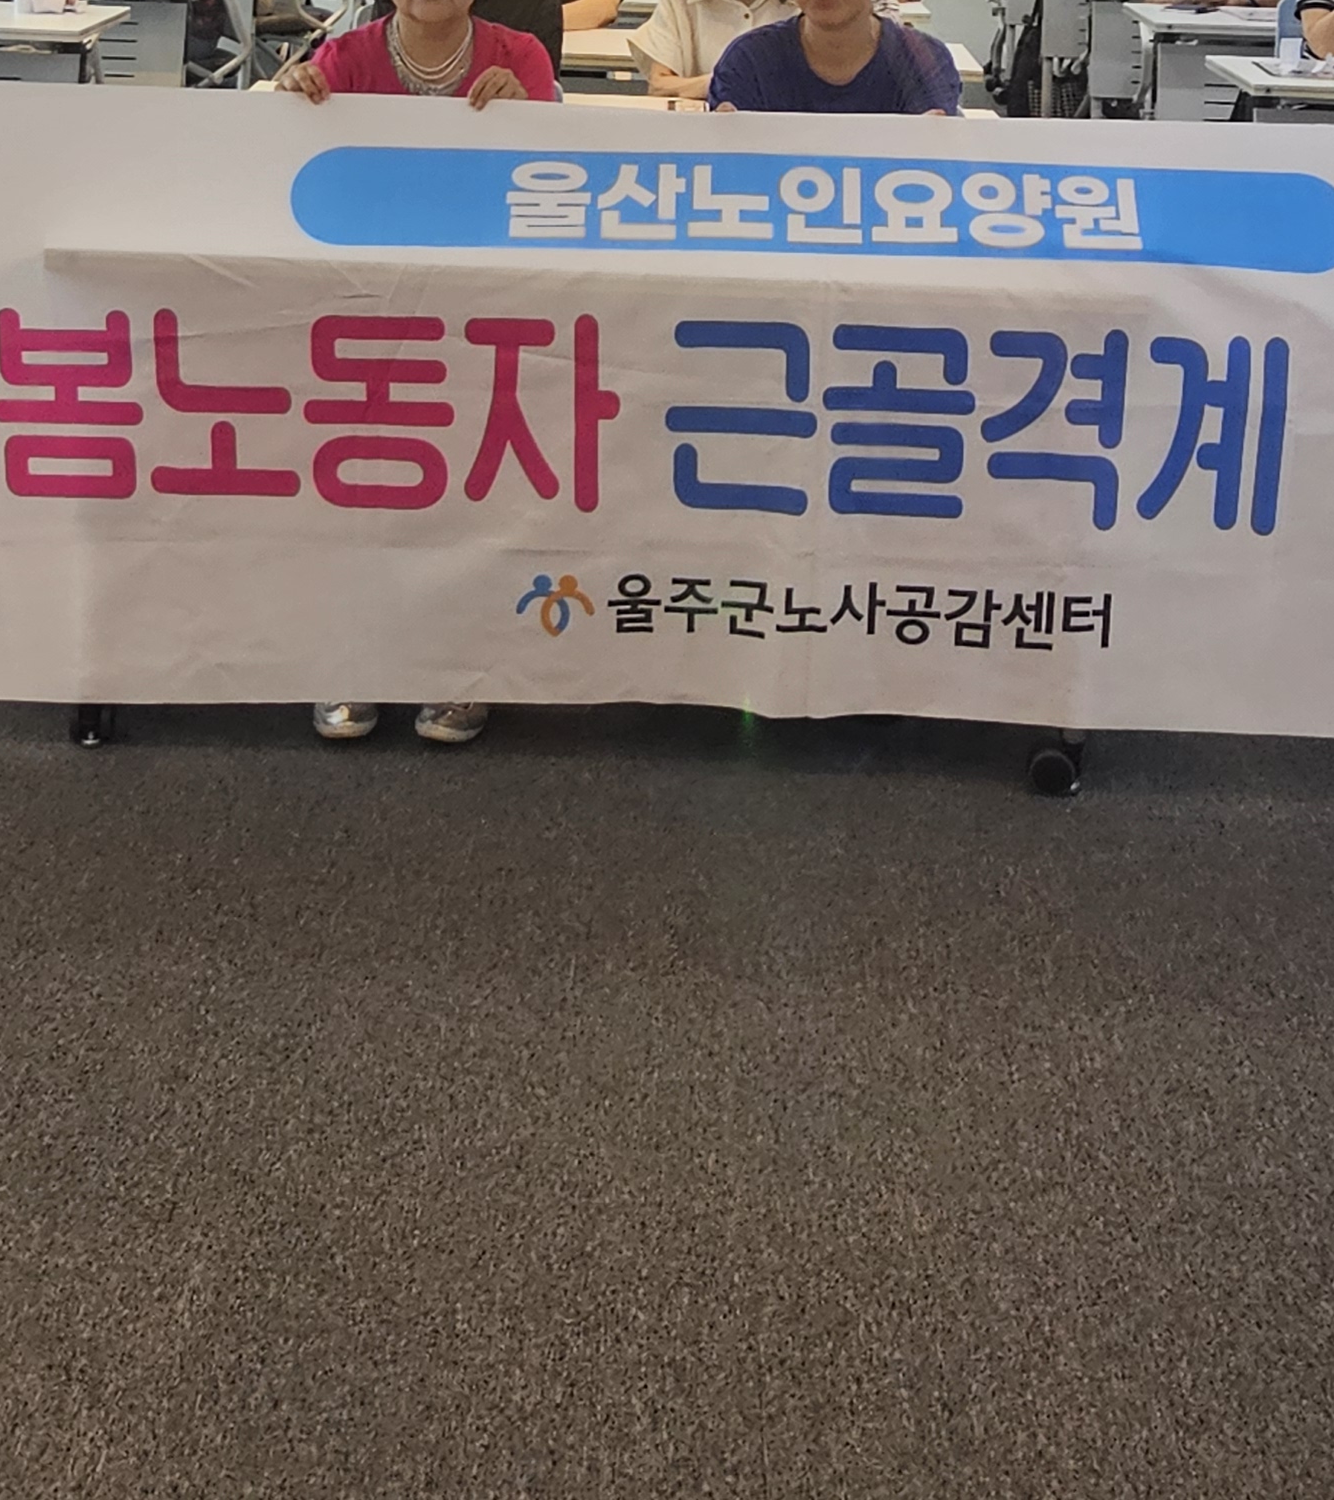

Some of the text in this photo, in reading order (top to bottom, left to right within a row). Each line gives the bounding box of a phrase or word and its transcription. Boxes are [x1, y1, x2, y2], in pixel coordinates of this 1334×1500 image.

[505, 161, 1143, 250] 울산노인요양원
[666, 320, 1289, 536] 근골격계
[607, 573, 1114, 650] 울주군노사공감센터
